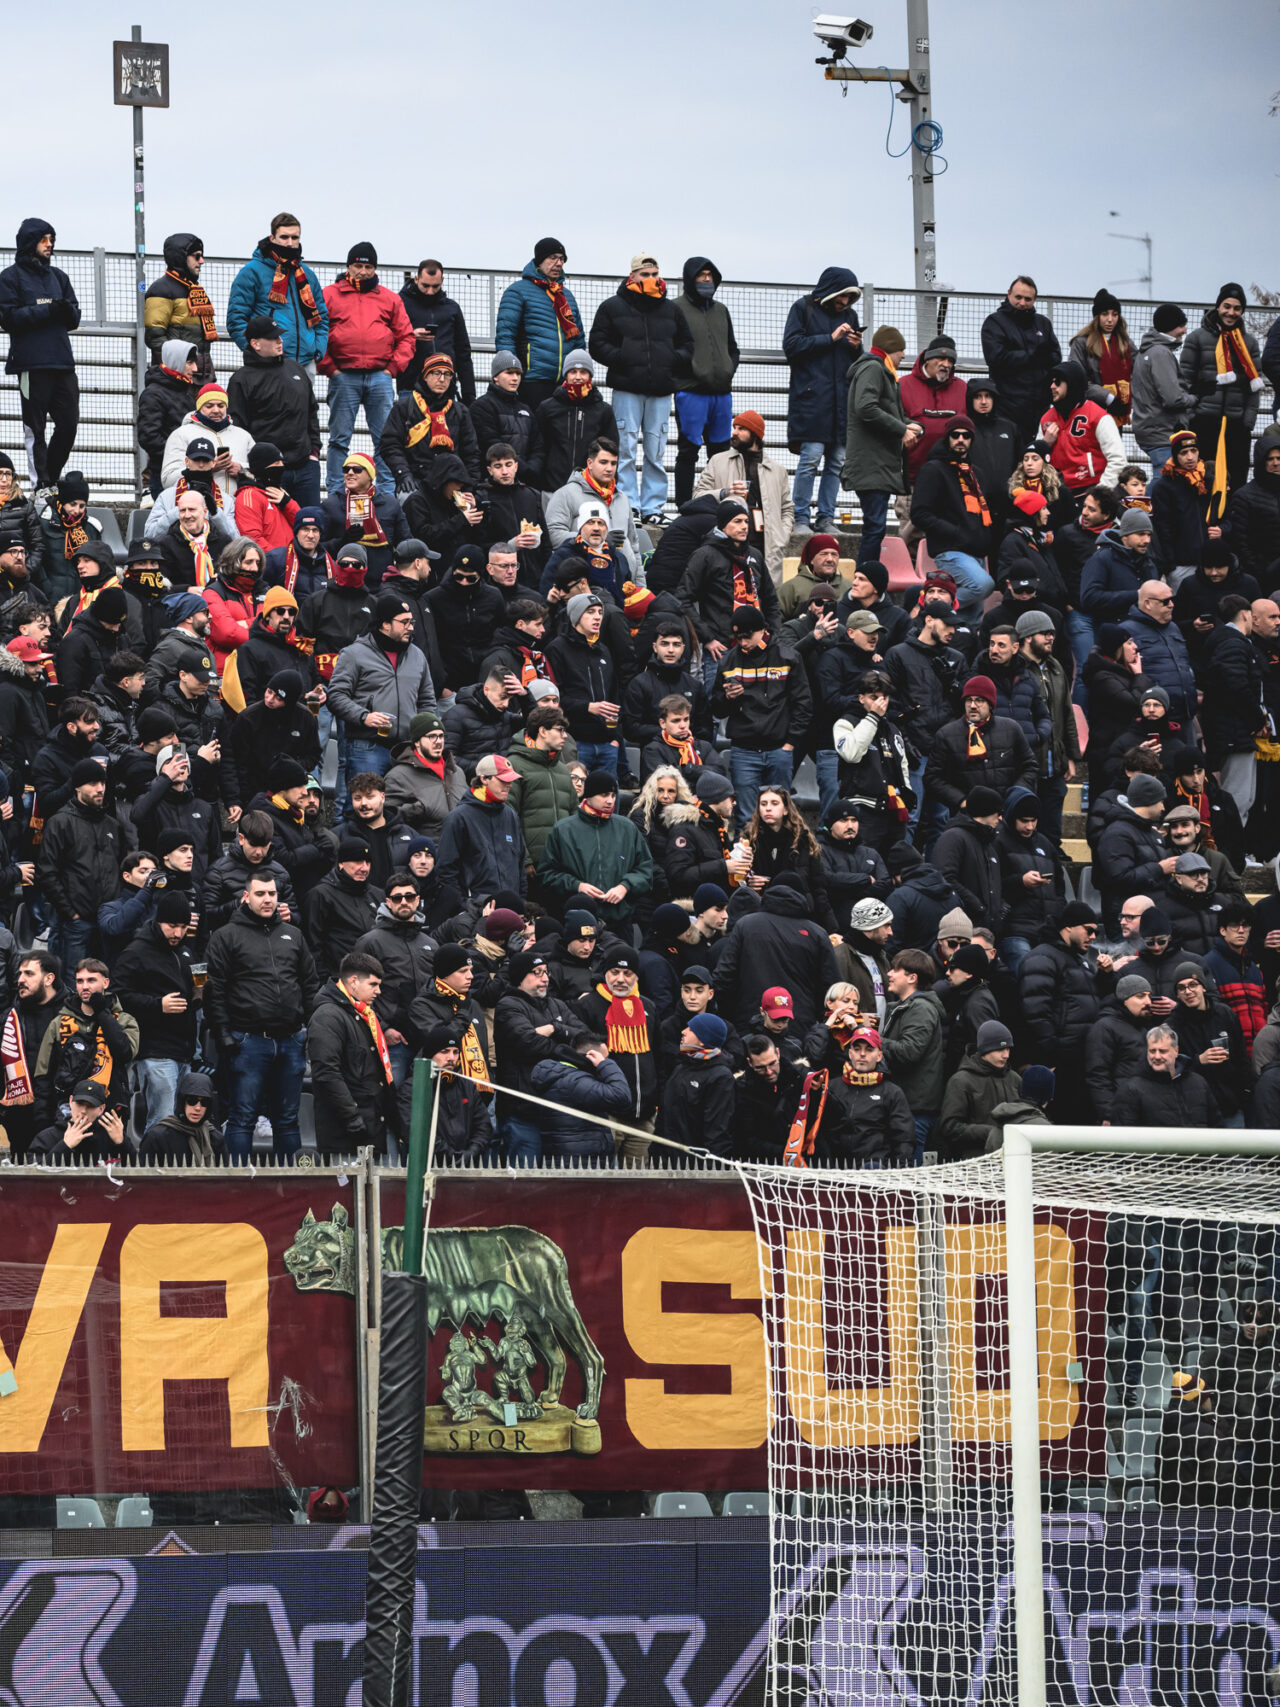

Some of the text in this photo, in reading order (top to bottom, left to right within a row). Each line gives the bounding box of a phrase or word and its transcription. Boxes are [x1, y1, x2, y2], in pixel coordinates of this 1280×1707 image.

[1070, 415, 1088, 437] C
[622, 1223, 1081, 1450] SUD
[448, 1428, 533, 1452] SPQR
